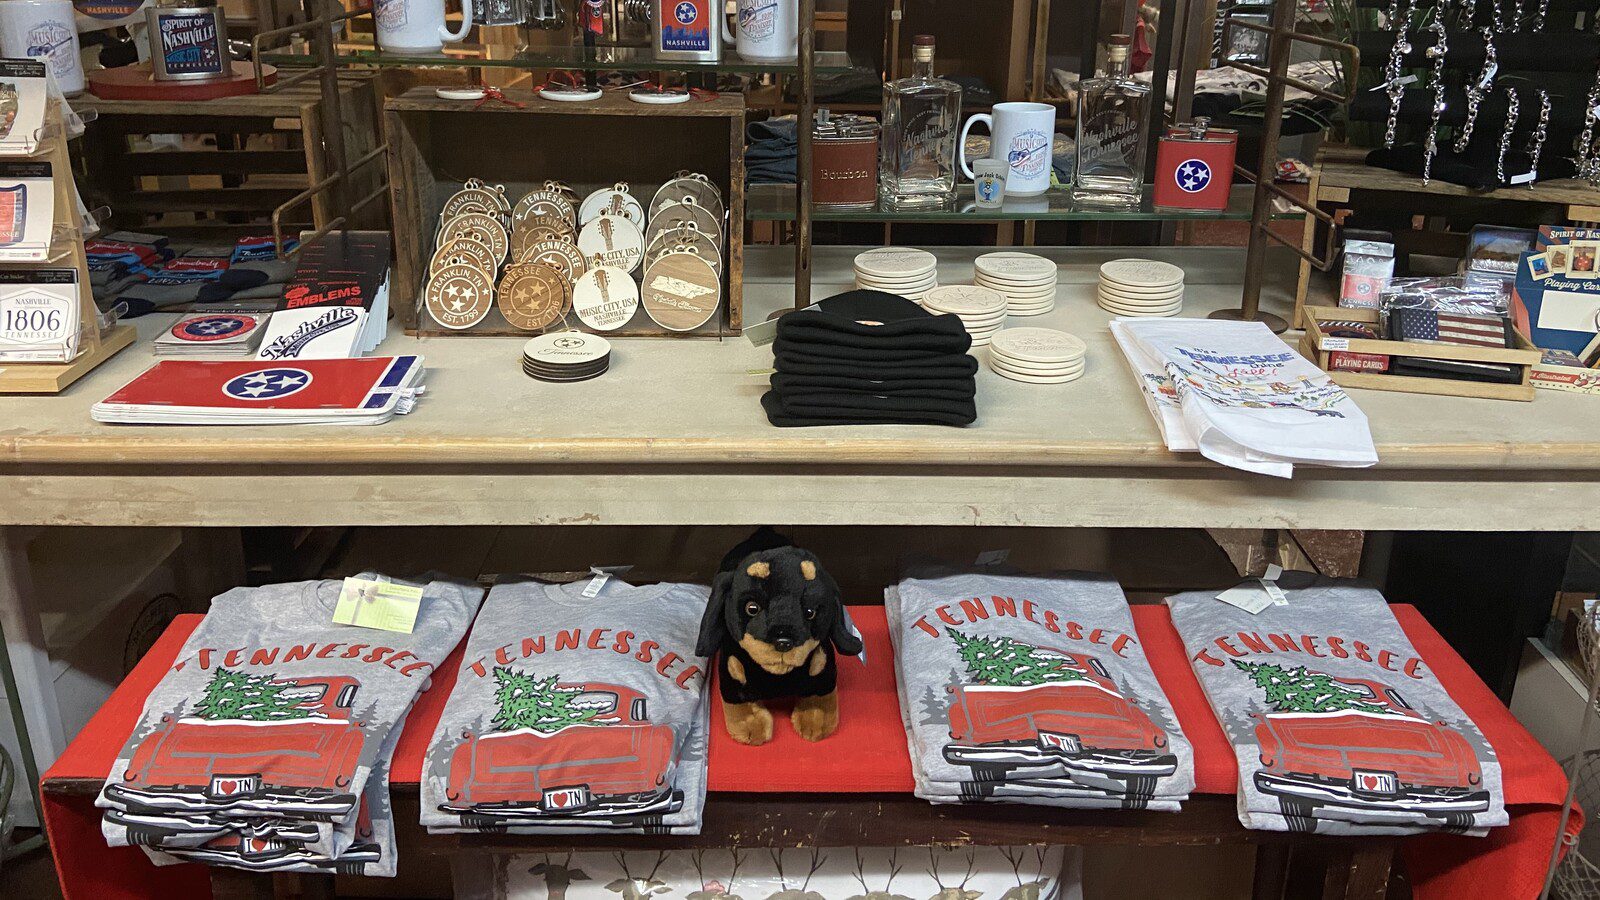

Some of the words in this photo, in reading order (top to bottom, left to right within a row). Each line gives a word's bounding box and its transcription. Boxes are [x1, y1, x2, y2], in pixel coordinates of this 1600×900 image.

[162, 19, 193, 32] SPIRIT
[194, 18, 205, 26] OF
[163, 24, 215, 52] NASHVILLE
[1083, 116, 1137, 143] Nashville
[1082, 132, 1139, 160] Tennessee
[820, 168, 868, 180] Bourbon
[447, 193, 485, 216] FRANKLIN,
[523, 192, 572, 214] TENNESSEE
[495, 238, 503, 250] TN
[1550, 230, 1574, 239] SPIRIT
[536, 240, 582, 268] TENNESSEE
[626, 246, 641, 257] USA
[484, 259, 492, 272] TN
[432, 269, 472, 293] FRANKLIN,
[473, 274, 484, 287] TN
[501, 267, 542, 299] TENNESSEE
[1544, 278, 1581, 291] Playing
[287, 286, 361, 309] EMBLEMS
[579, 305, 603, 319] MUSIC
[623, 296, 638, 308] USA
[5, 309, 61, 332] 1806
[442, 313, 459, 324] EST.
[461, 310, 479, 323] 1799
[593, 308, 627, 322] NASHVILLE
[5, 331, 59, 339] TENNESSEE
[261, 307, 356, 360] Nashville
[1175, 346, 1295, 365] TENNESSEE
[1335, 358, 1362, 369] PLAYING
[1362, 360, 1385, 369] CARDS
[910, 594, 1138, 660] TENNESSEE
[171, 641, 435, 680] TENNESSEE
[465, 627, 709, 692] TENNESSEE
[1192, 631, 1428, 680] TENNESSEE
[1059, 739, 1076, 752] TN
[213, 777, 222, 796] I
[236, 777, 253, 794] TN
[1357, 774, 1364, 790] I
[1378, 775, 1393, 793] TN
[547, 792, 555, 808] I
[566, 789, 583, 805] TN
